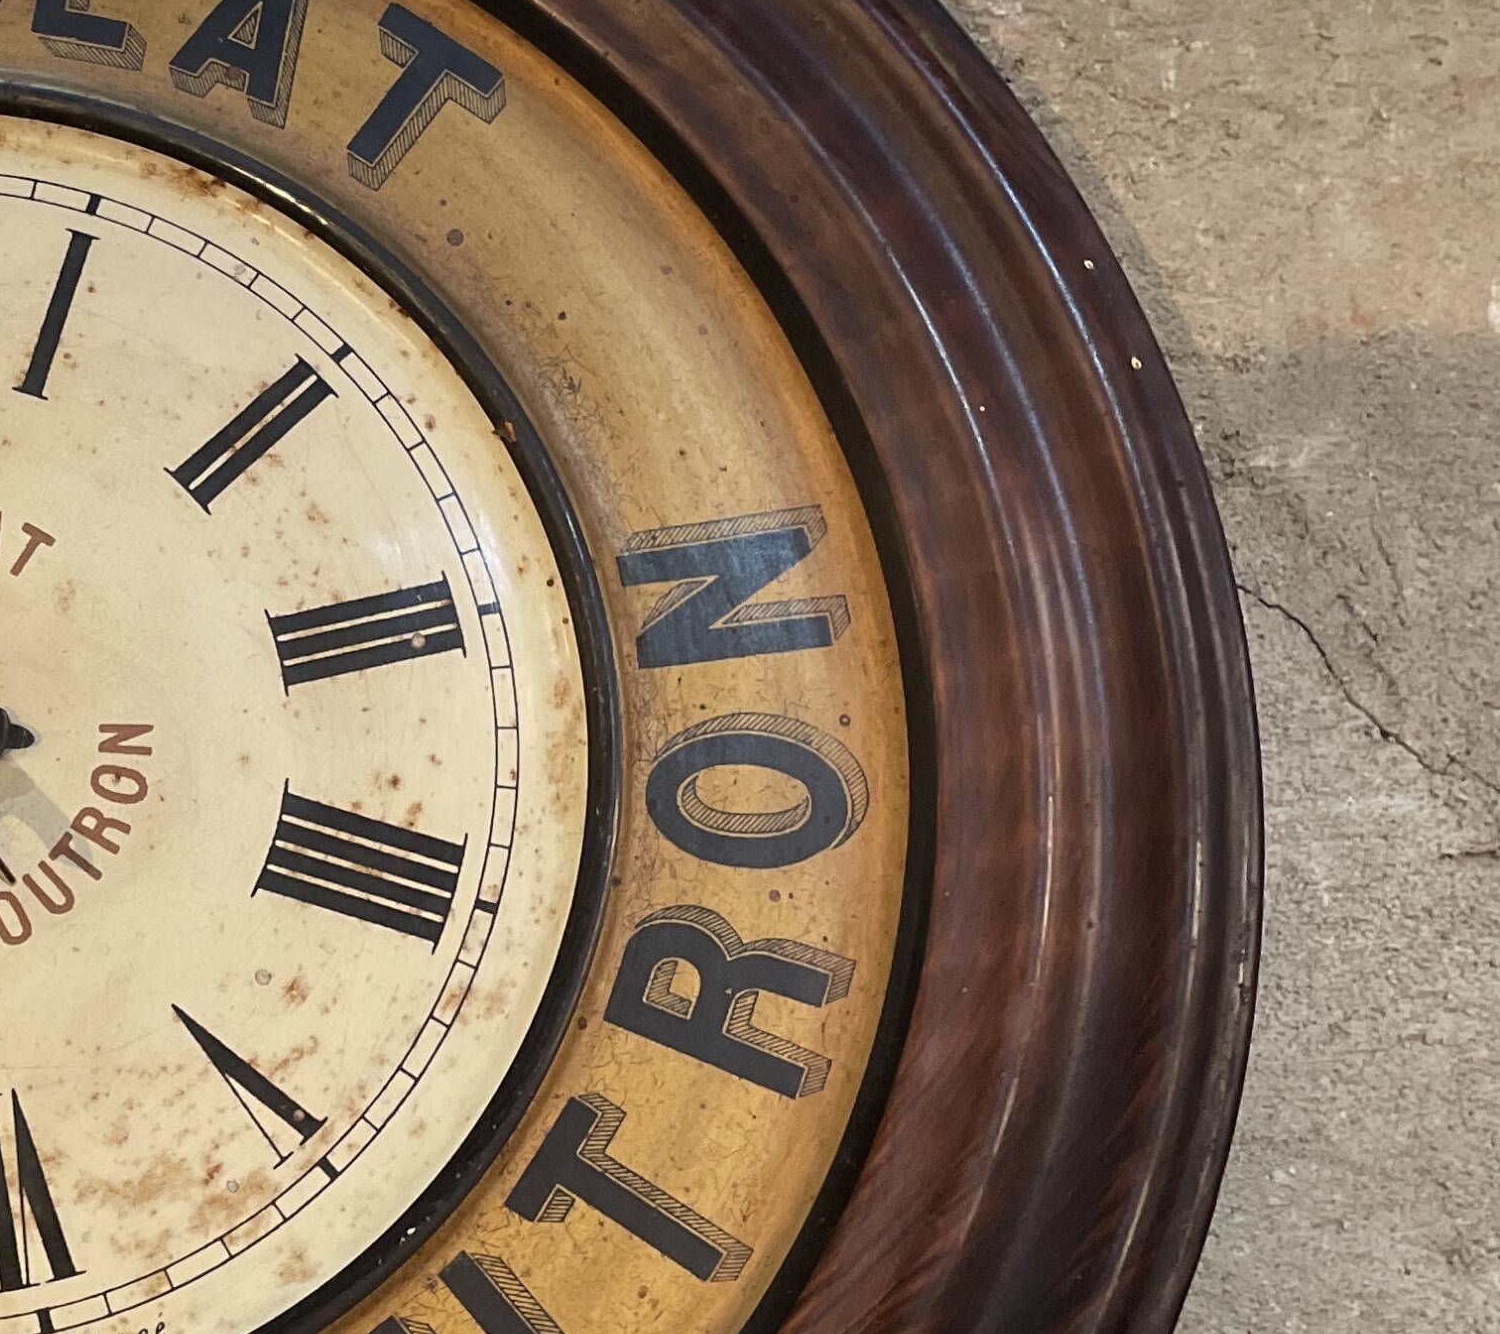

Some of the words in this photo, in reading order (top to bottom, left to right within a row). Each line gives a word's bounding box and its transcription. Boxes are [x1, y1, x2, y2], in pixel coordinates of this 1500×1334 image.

[11, 227, 99, 399] I
[164, 352, 338, 514] II
[264, 571, 467, 697] III
[250, 778, 468, 954] IIII
[171, 1004, 328, 1168] V
